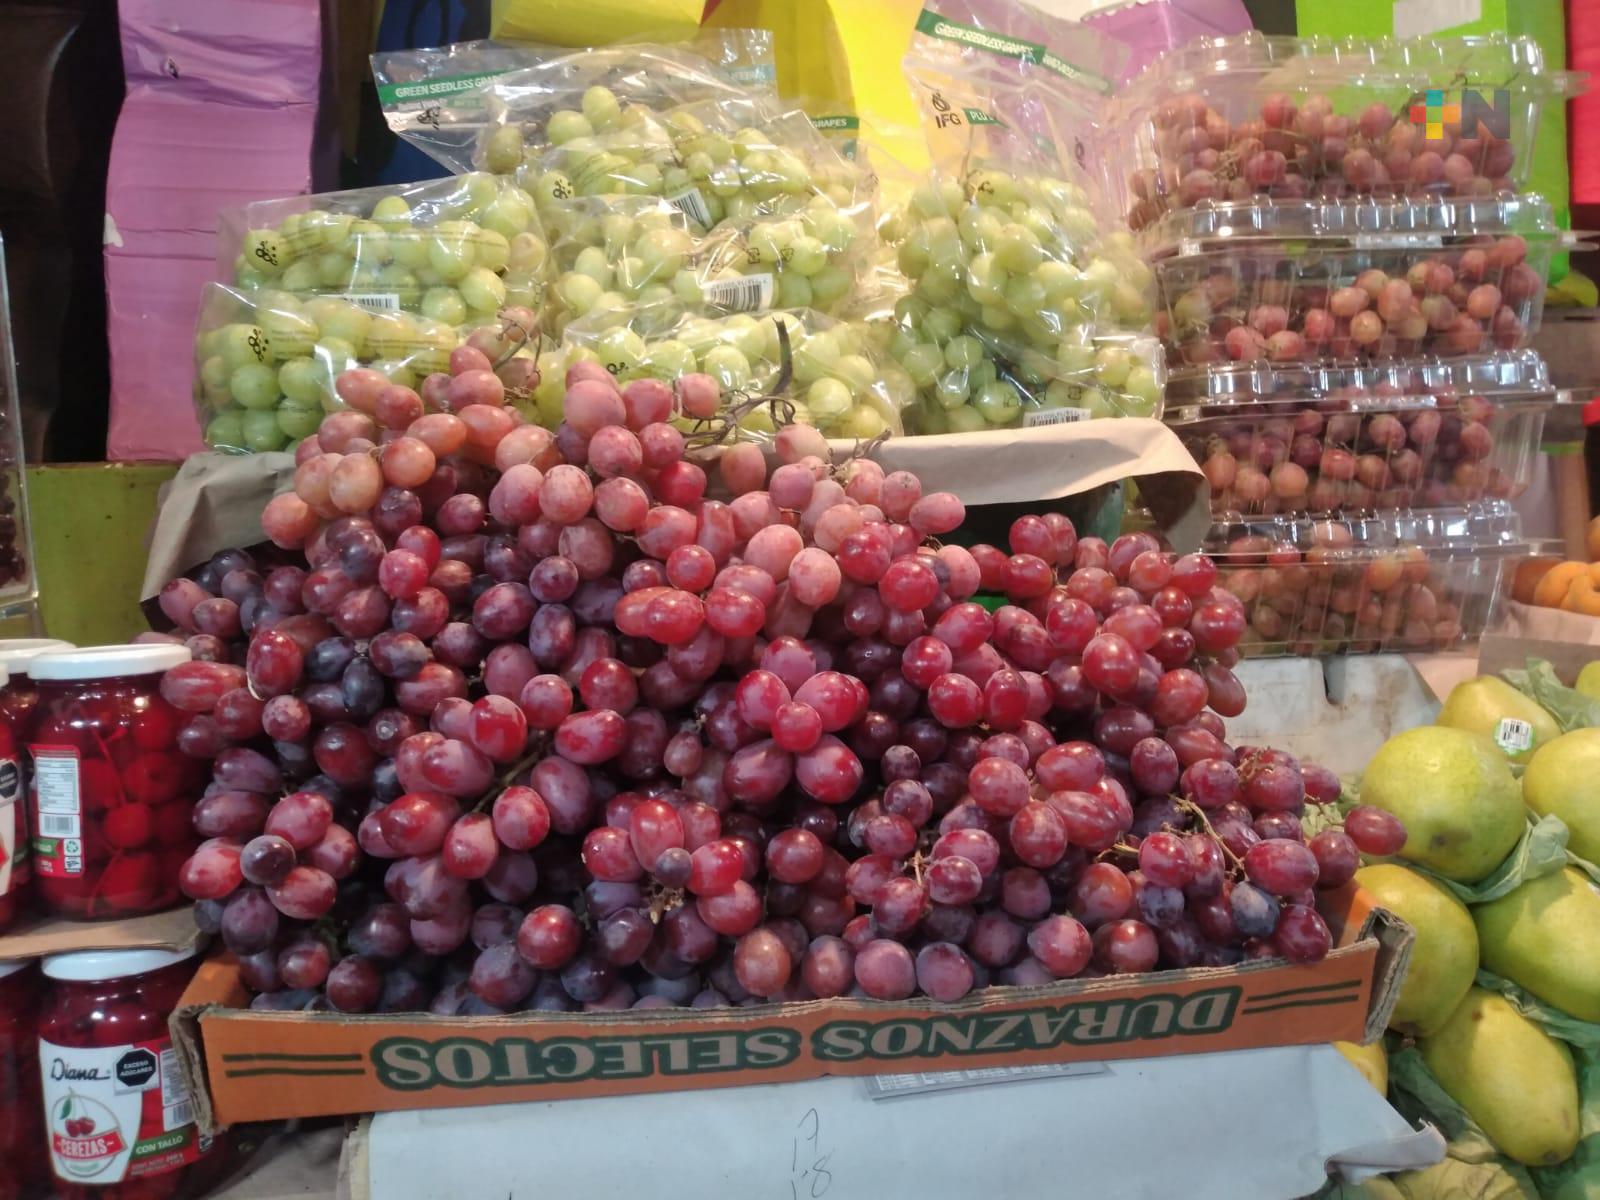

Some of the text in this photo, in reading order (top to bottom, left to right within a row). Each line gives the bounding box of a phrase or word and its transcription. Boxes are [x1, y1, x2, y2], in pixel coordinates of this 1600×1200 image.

[395, 84, 429, 98] GREEN
[429, 79, 474, 93] SEEDLESS
[935, 112, 962, 128] IFG
[377, 989, 1237, 1088] DURAZNOS SELECTOS
[51, 1057, 110, 1082] Diana
[60, 1139, 108, 1157] CEREZAS
[136, 1135, 183, 1155] CON TALLO
